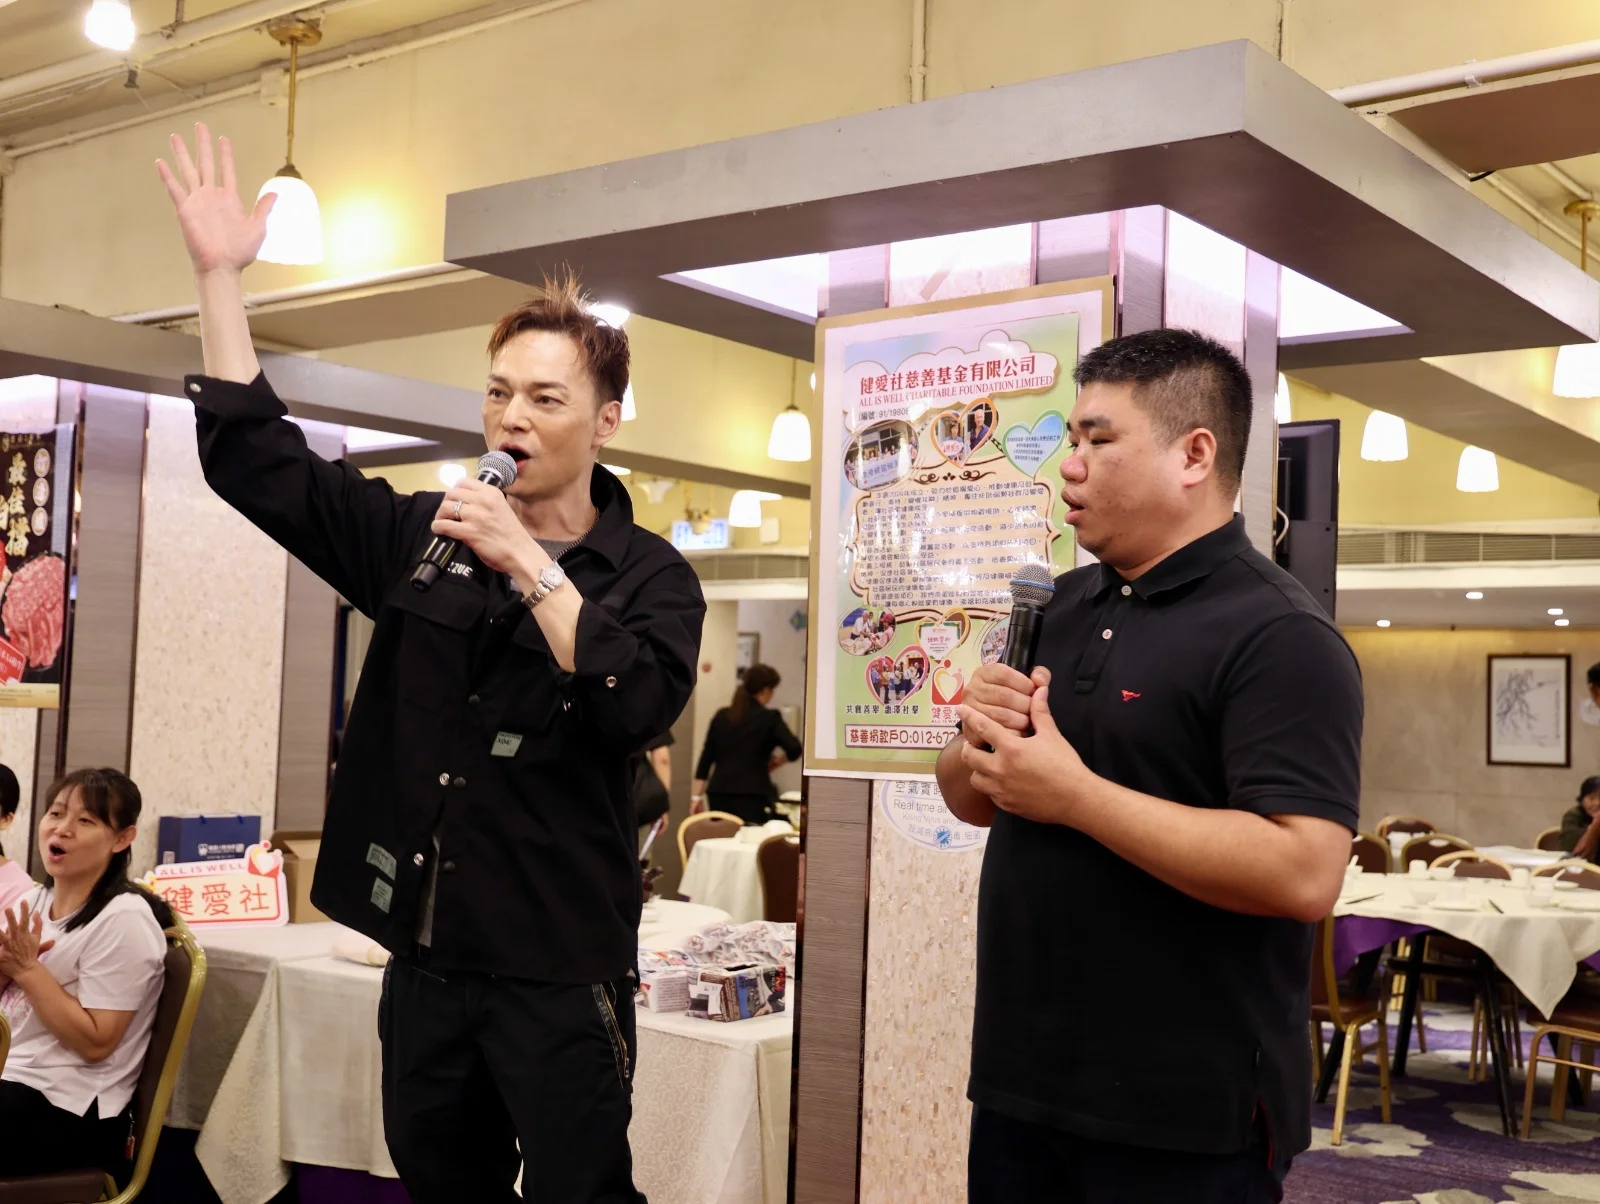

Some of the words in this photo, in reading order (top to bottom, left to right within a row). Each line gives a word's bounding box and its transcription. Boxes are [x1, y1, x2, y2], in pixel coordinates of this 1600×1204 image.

[858, 397, 873, 408] ALL
[874, 396, 882, 406] IS
[883, 392, 905, 405] WELL
[906, 386, 958, 402] CHARITABLE
[959, 379, 1015, 396] FOUNDATION
[1015, 375, 1053, 392] LIMITED
[860, 355, 1036, 396] 健愛社慈善基金有限公司
[893, 798, 914, 811] Real
[916, 801, 935, 813] time
[937, 804, 948, 815] air
[160, 866, 187, 876] ALL
[190, 865, 203, 874] IS
[205, 862, 245, 873] WELL
[160, 882, 270, 917] 健愛社
